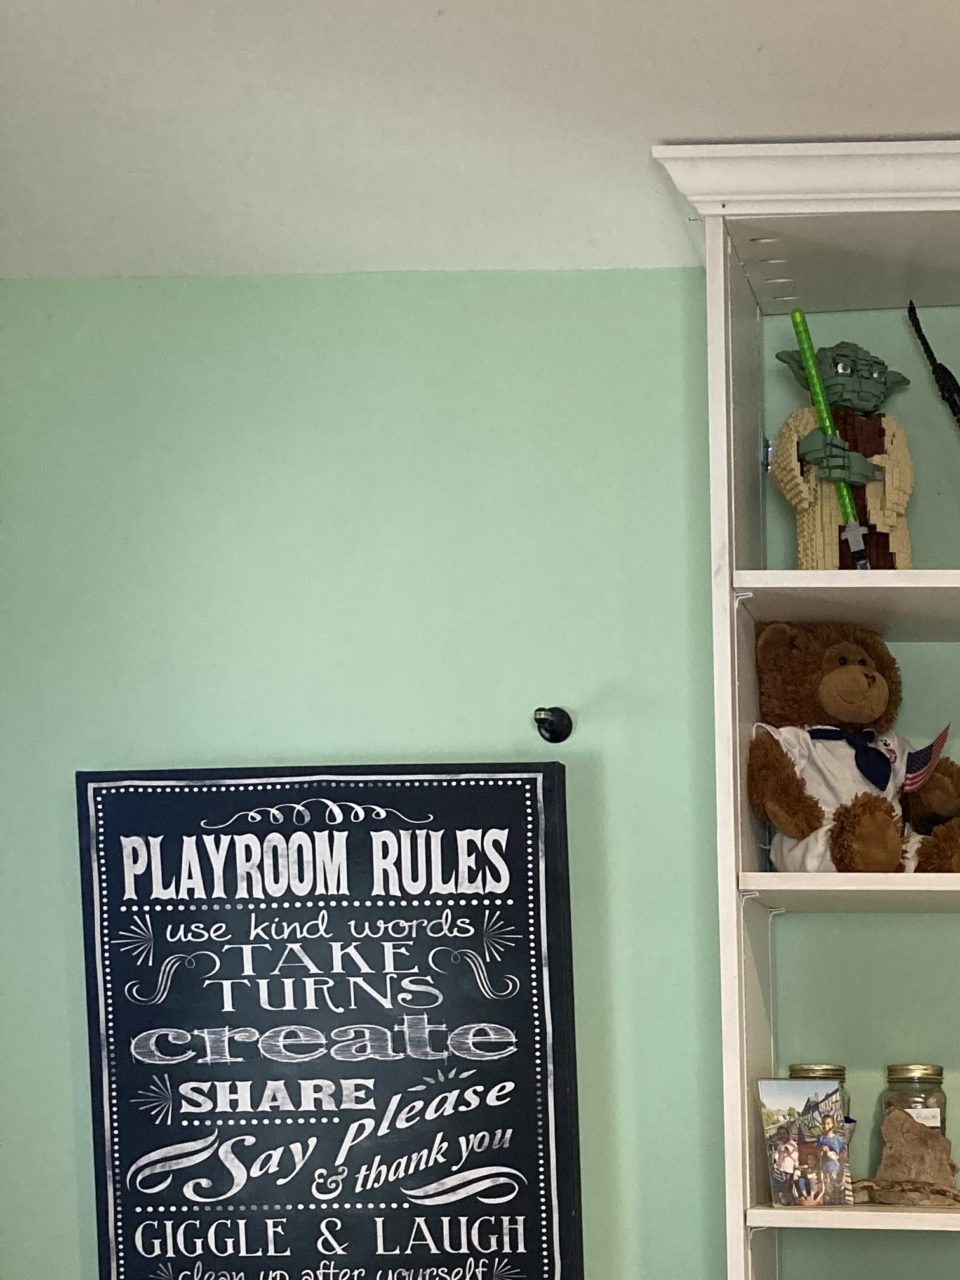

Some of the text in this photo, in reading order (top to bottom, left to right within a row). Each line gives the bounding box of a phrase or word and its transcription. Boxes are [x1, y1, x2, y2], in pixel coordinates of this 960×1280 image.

[119, 828, 511, 901] PLAYROOM RULES
[166, 910, 476, 943] use kind words
[223, 941, 419, 975] TAKE
[202, 975, 445, 1013] TURNS
[130, 1013, 519, 1065] create
[179, 1078, 376, 1112] SHARE
[184, 1080, 516, 1202] Say please
[312, 1128, 514, 1199] & thank you
[134, 1214, 527, 1258] GIGGLE & LAUGH
